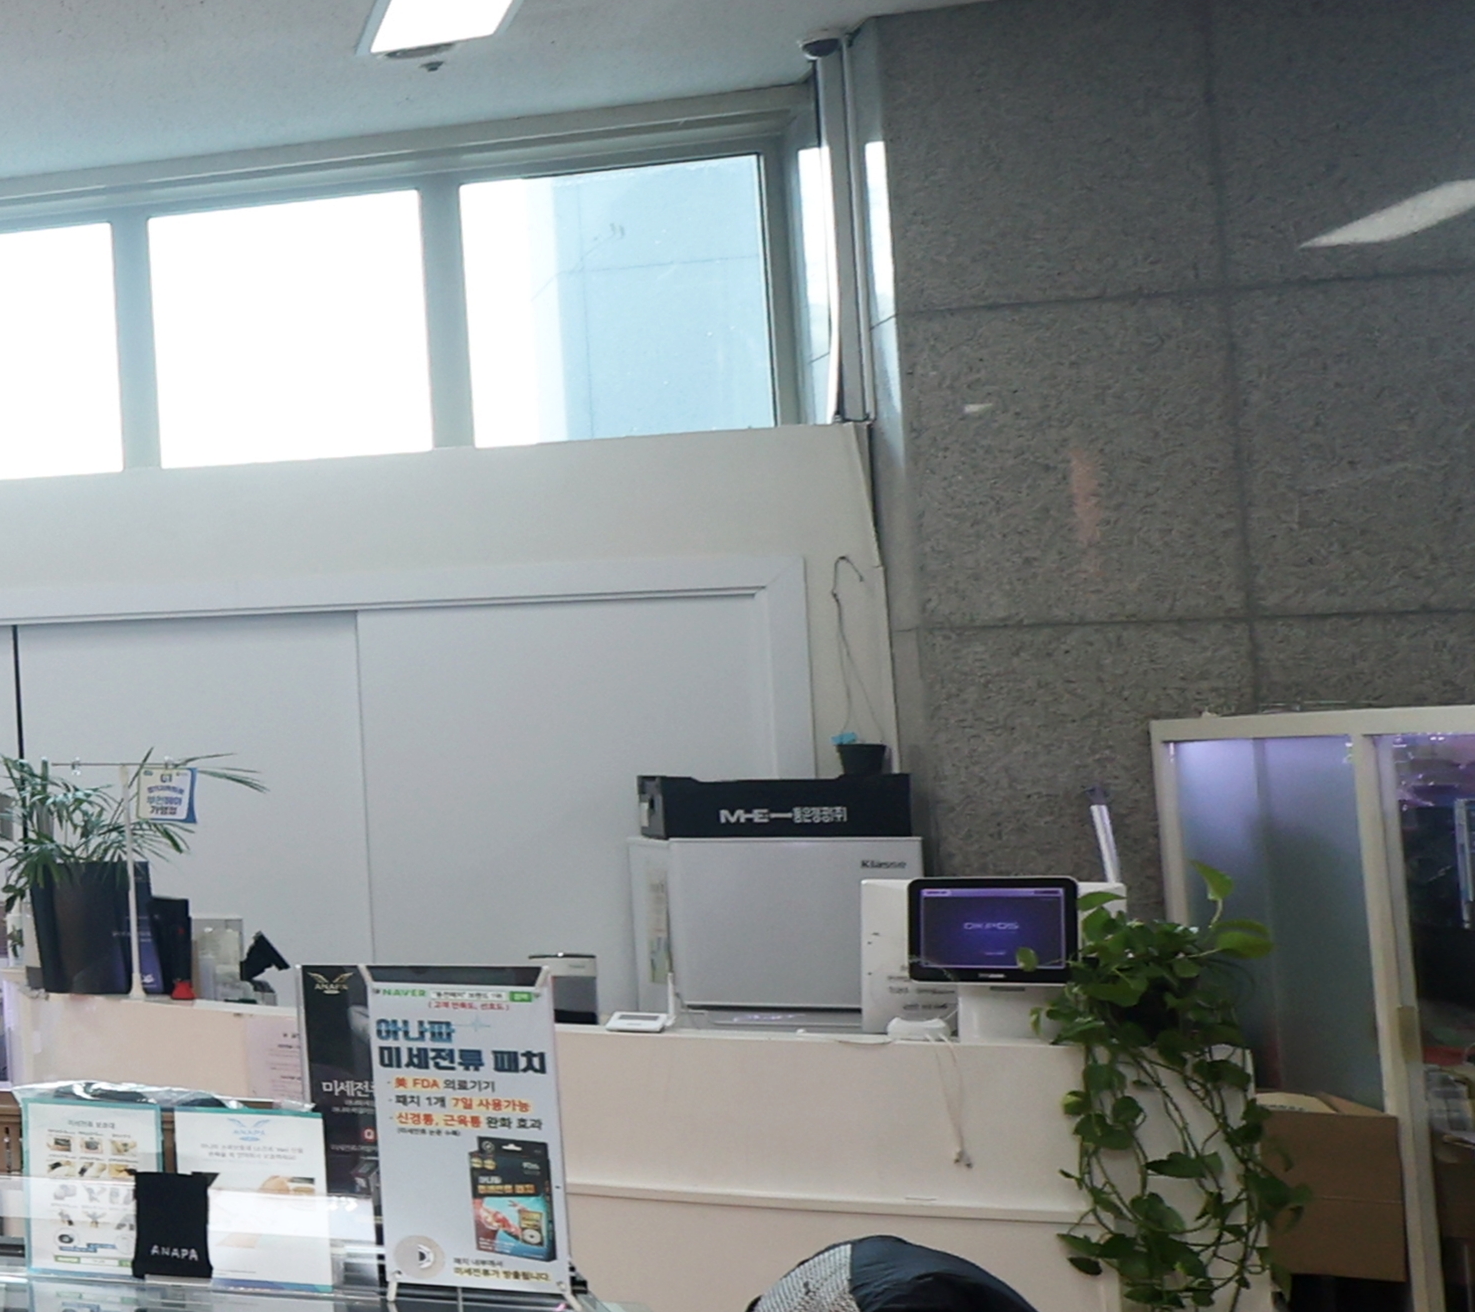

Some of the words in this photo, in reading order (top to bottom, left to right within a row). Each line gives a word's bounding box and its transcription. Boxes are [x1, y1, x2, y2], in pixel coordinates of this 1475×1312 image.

[382, 989, 426, 997] NAVER
[376, 1018, 455, 1043] 아나파
[378, 1046, 484, 1073] 미세전류
[492, 1050, 547, 1075] 패치
[321, 1080, 375, 1097] 미세전
[412, 1078, 440, 1090] FDA
[443, 1079, 496, 1093] 의료기기
[395, 1095, 420, 1107] 패치
[426, 1096, 446, 1108] 1개
[452, 1097, 473, 1110] 7일
[477, 1099, 531, 1112] 사용가능
[397, 1113, 438, 1127] 신경통,
[443, 1114, 482, 1128] 근육통
[486, 1117, 512, 1130] 완화
[516, 1118, 543, 1131] 효과
[151, 1244, 199, 1262] ANAPA
